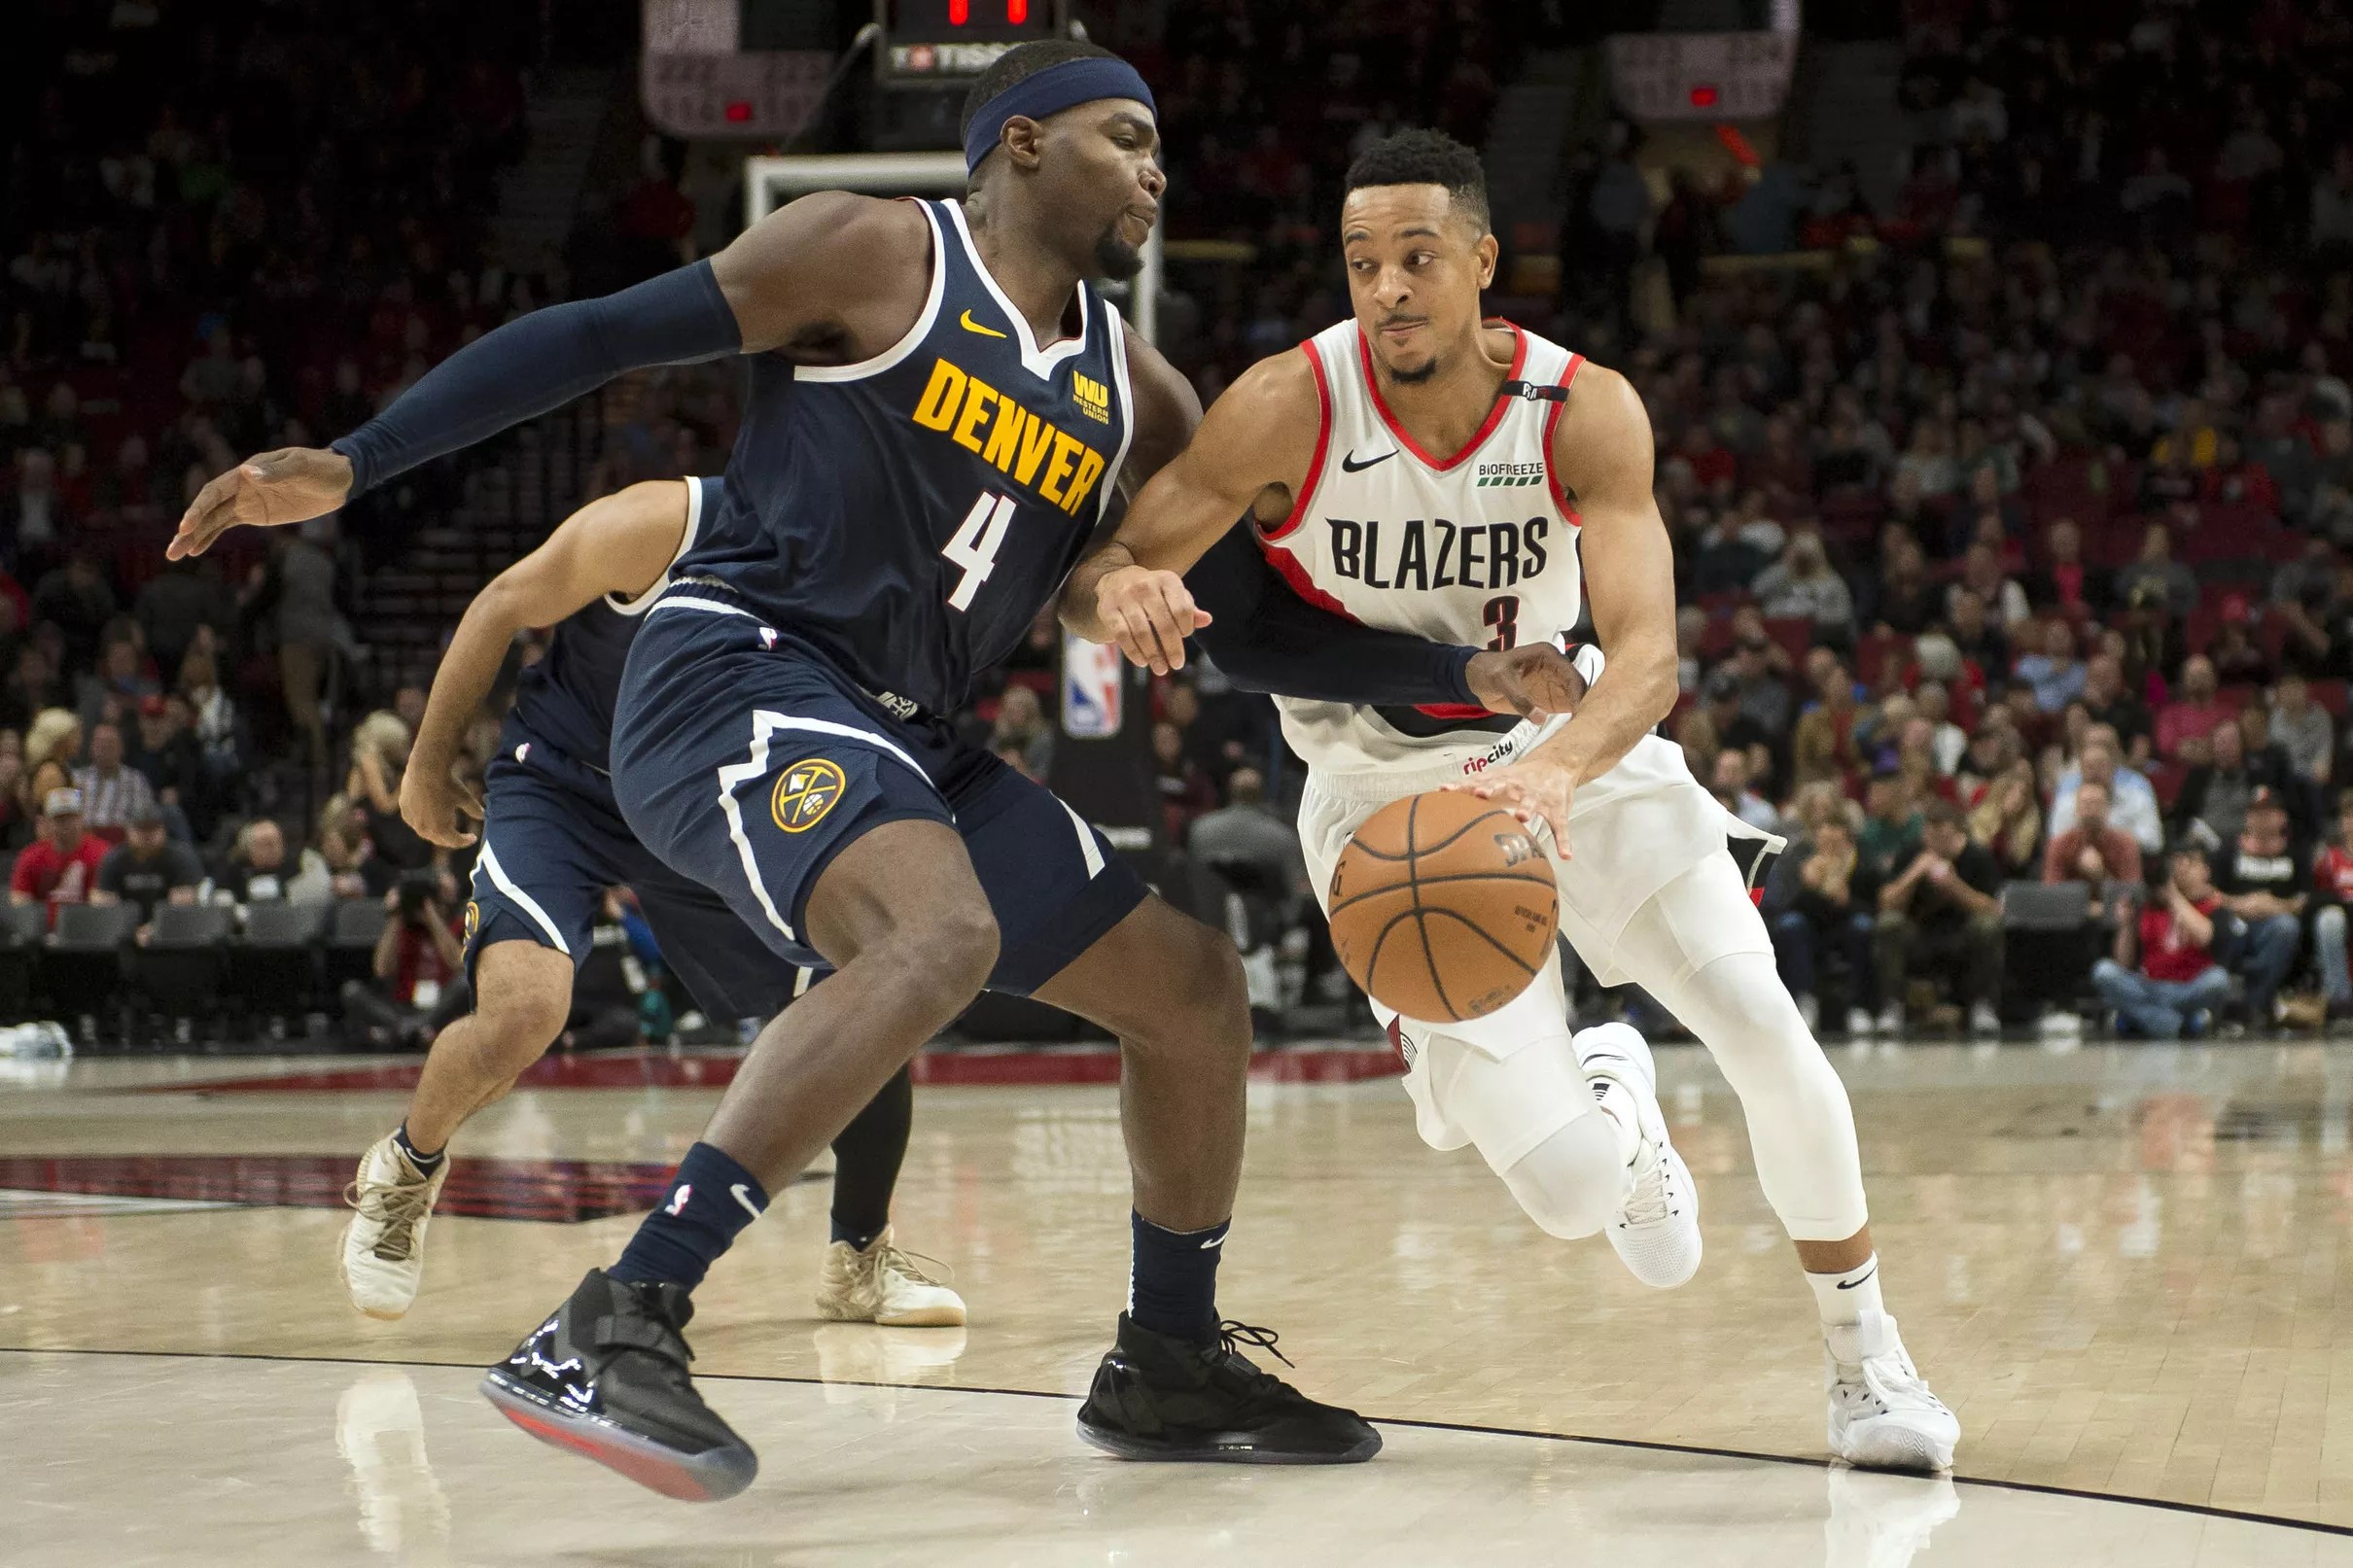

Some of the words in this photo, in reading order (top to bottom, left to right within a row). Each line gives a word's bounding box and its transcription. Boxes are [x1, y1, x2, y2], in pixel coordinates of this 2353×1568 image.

[1072, 369, 1108, 408] WU
[1072, 394, 1108, 418] WESTERN
[1082, 406, 1108, 425] UNION
[912, 358, 1105, 518] DENVER
[1479, 462, 1544, 475] BIOFREEZE
[941, 491, 1017, 611] 4
[1324, 516, 1549, 590] BLAZERS
[1483, 595, 1520, 652] 3
[1463, 740, 1513, 775] ripcity
